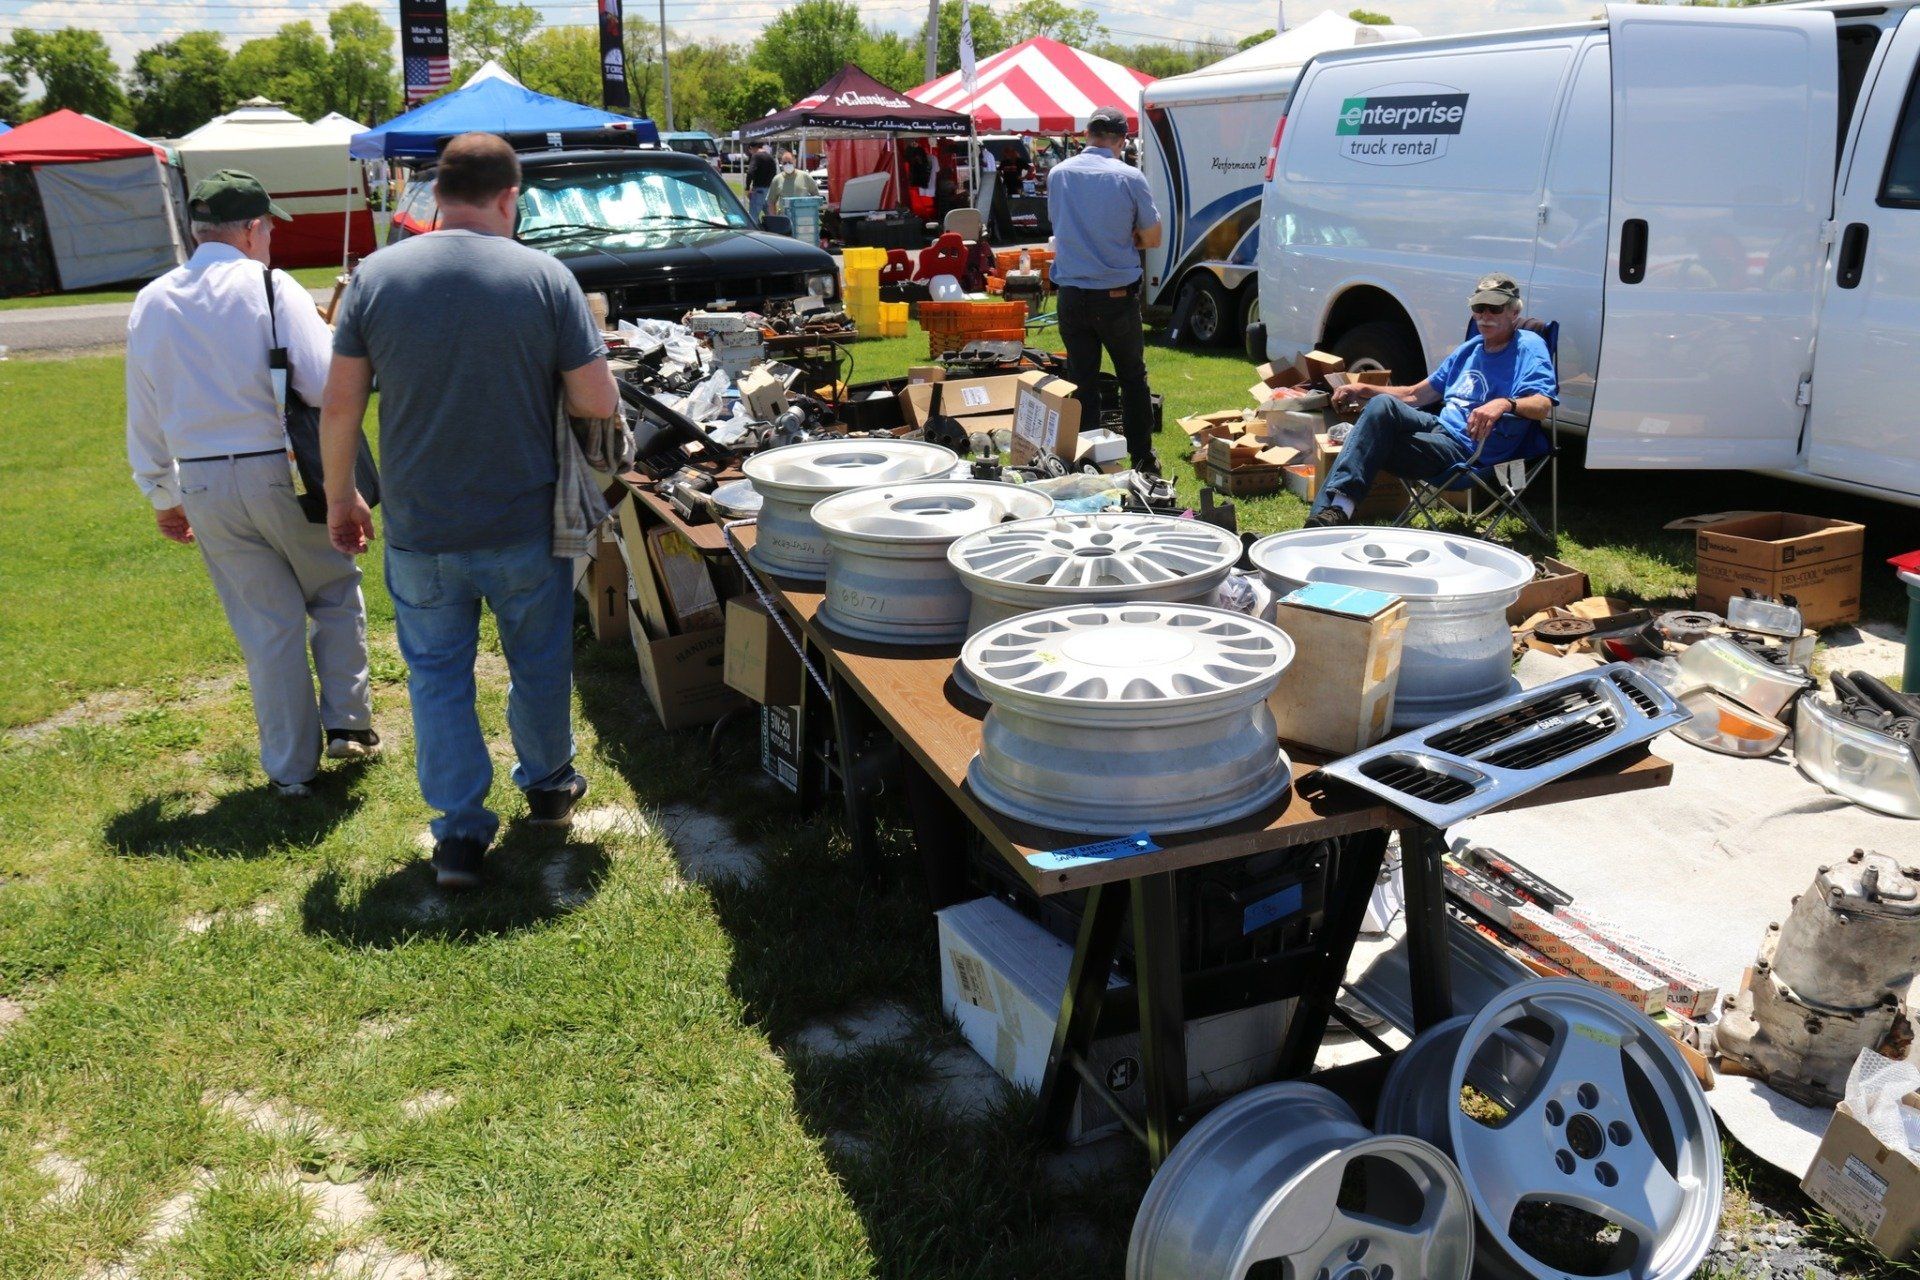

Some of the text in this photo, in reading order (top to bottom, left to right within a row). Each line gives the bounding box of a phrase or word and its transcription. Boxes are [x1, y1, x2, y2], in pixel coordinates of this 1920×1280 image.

[411, 26, 431, 34] Made
[412, 35, 444, 44] the USA
[1339, 101, 1463, 130] enterprise
[932, 121, 952, 131] Sports
[952, 122, 966, 131] Cars
[1351, 138, 1438, 155] truck rental
[1211, 157, 1256, 174] Performance
[1539, 716, 1562, 731] SAAB
[1476, 922, 1499, 939] GAS
[1615, 982, 1630, 990] GAS
[1667, 994, 1689, 1004] FLUID
